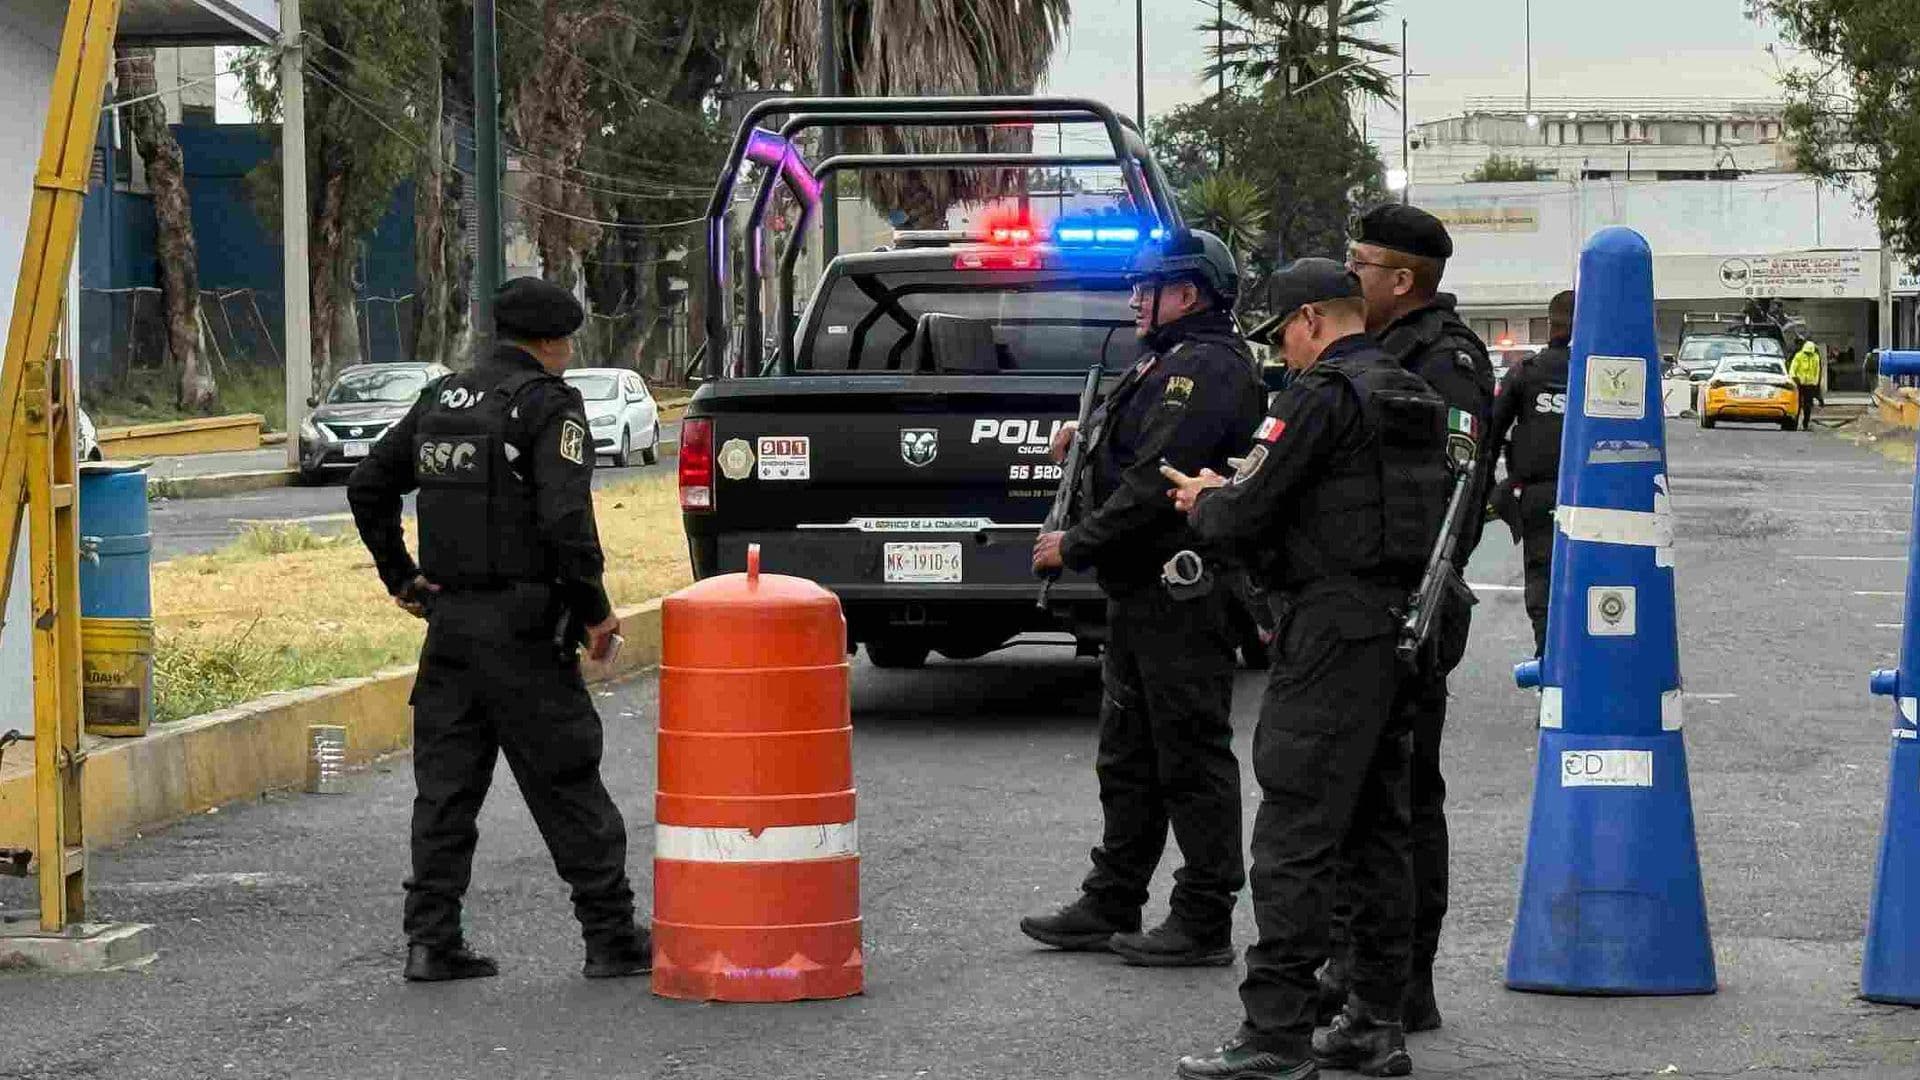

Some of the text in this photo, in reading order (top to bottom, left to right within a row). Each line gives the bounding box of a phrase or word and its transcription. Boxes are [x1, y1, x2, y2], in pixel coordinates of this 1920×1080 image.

[1535, 392, 1568, 414] SS
[970, 419, 1079, 445] POLI
[761, 440, 806, 456] 911
[1017, 446, 1050, 455] CIUDA
